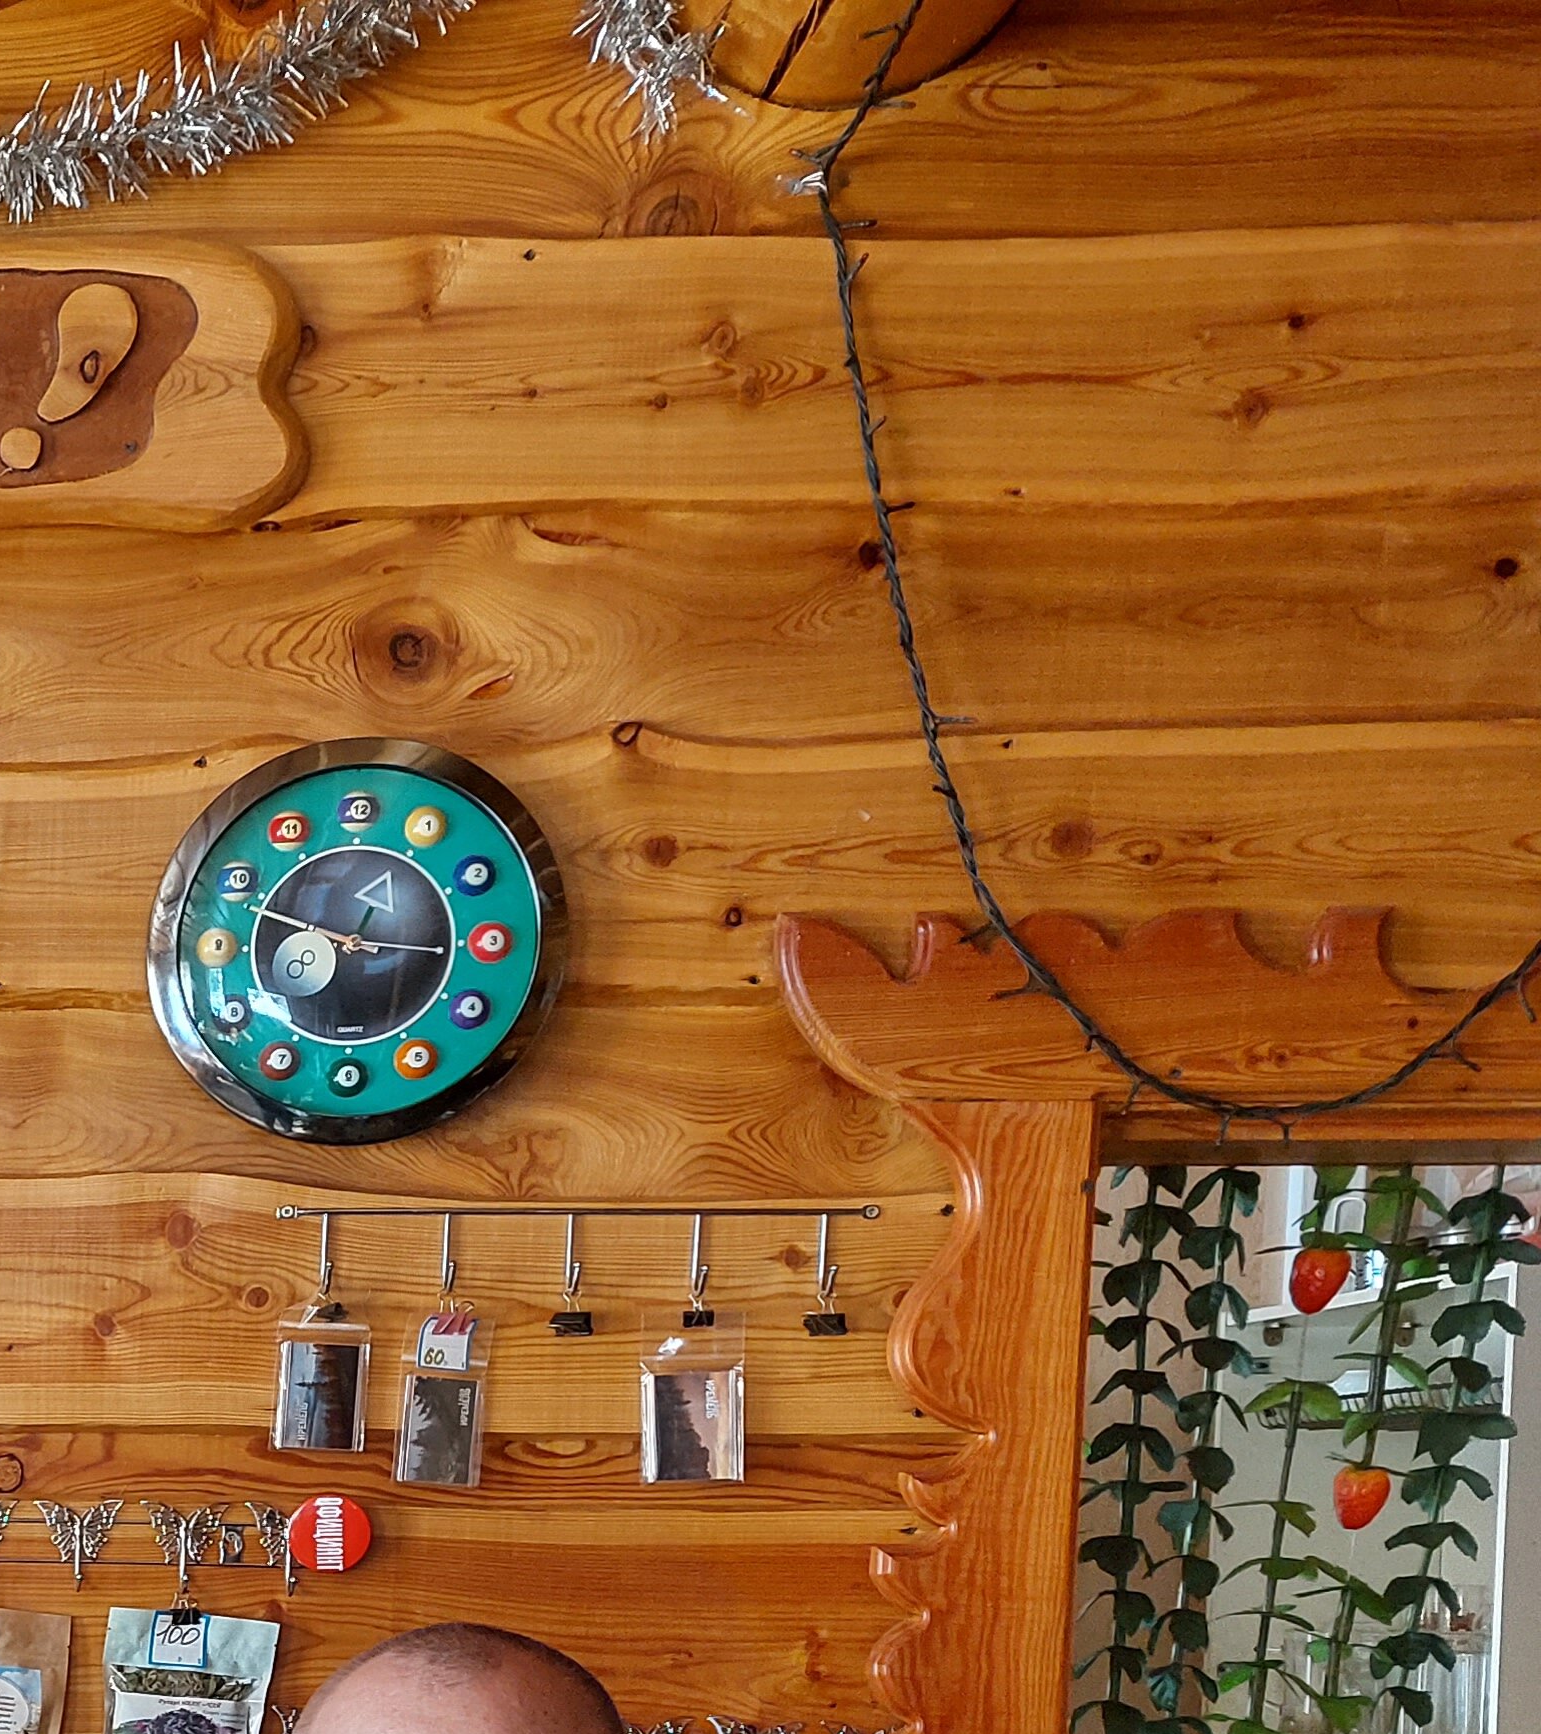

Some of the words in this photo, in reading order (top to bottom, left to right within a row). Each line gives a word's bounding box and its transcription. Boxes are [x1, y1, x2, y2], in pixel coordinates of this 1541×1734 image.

[352, 804, 369, 816] 12
[284, 824, 298, 835] 11
[425, 819, 432, 831] 1
[474, 867, 483, 878] 2
[232, 873, 247, 884] 10
[489, 935, 498, 946] 3
[230, 1007, 239, 1017] 8
[467, 1001, 476, 1012] 4
[277, 1053, 287, 1065] 7
[414, 1051, 423, 1062] 5
[344, 1070, 353, 1081] 6
[313, 1496, 344, 1571] ОФИЦИАНТ
[156, 1624, 201, 1645] 100
